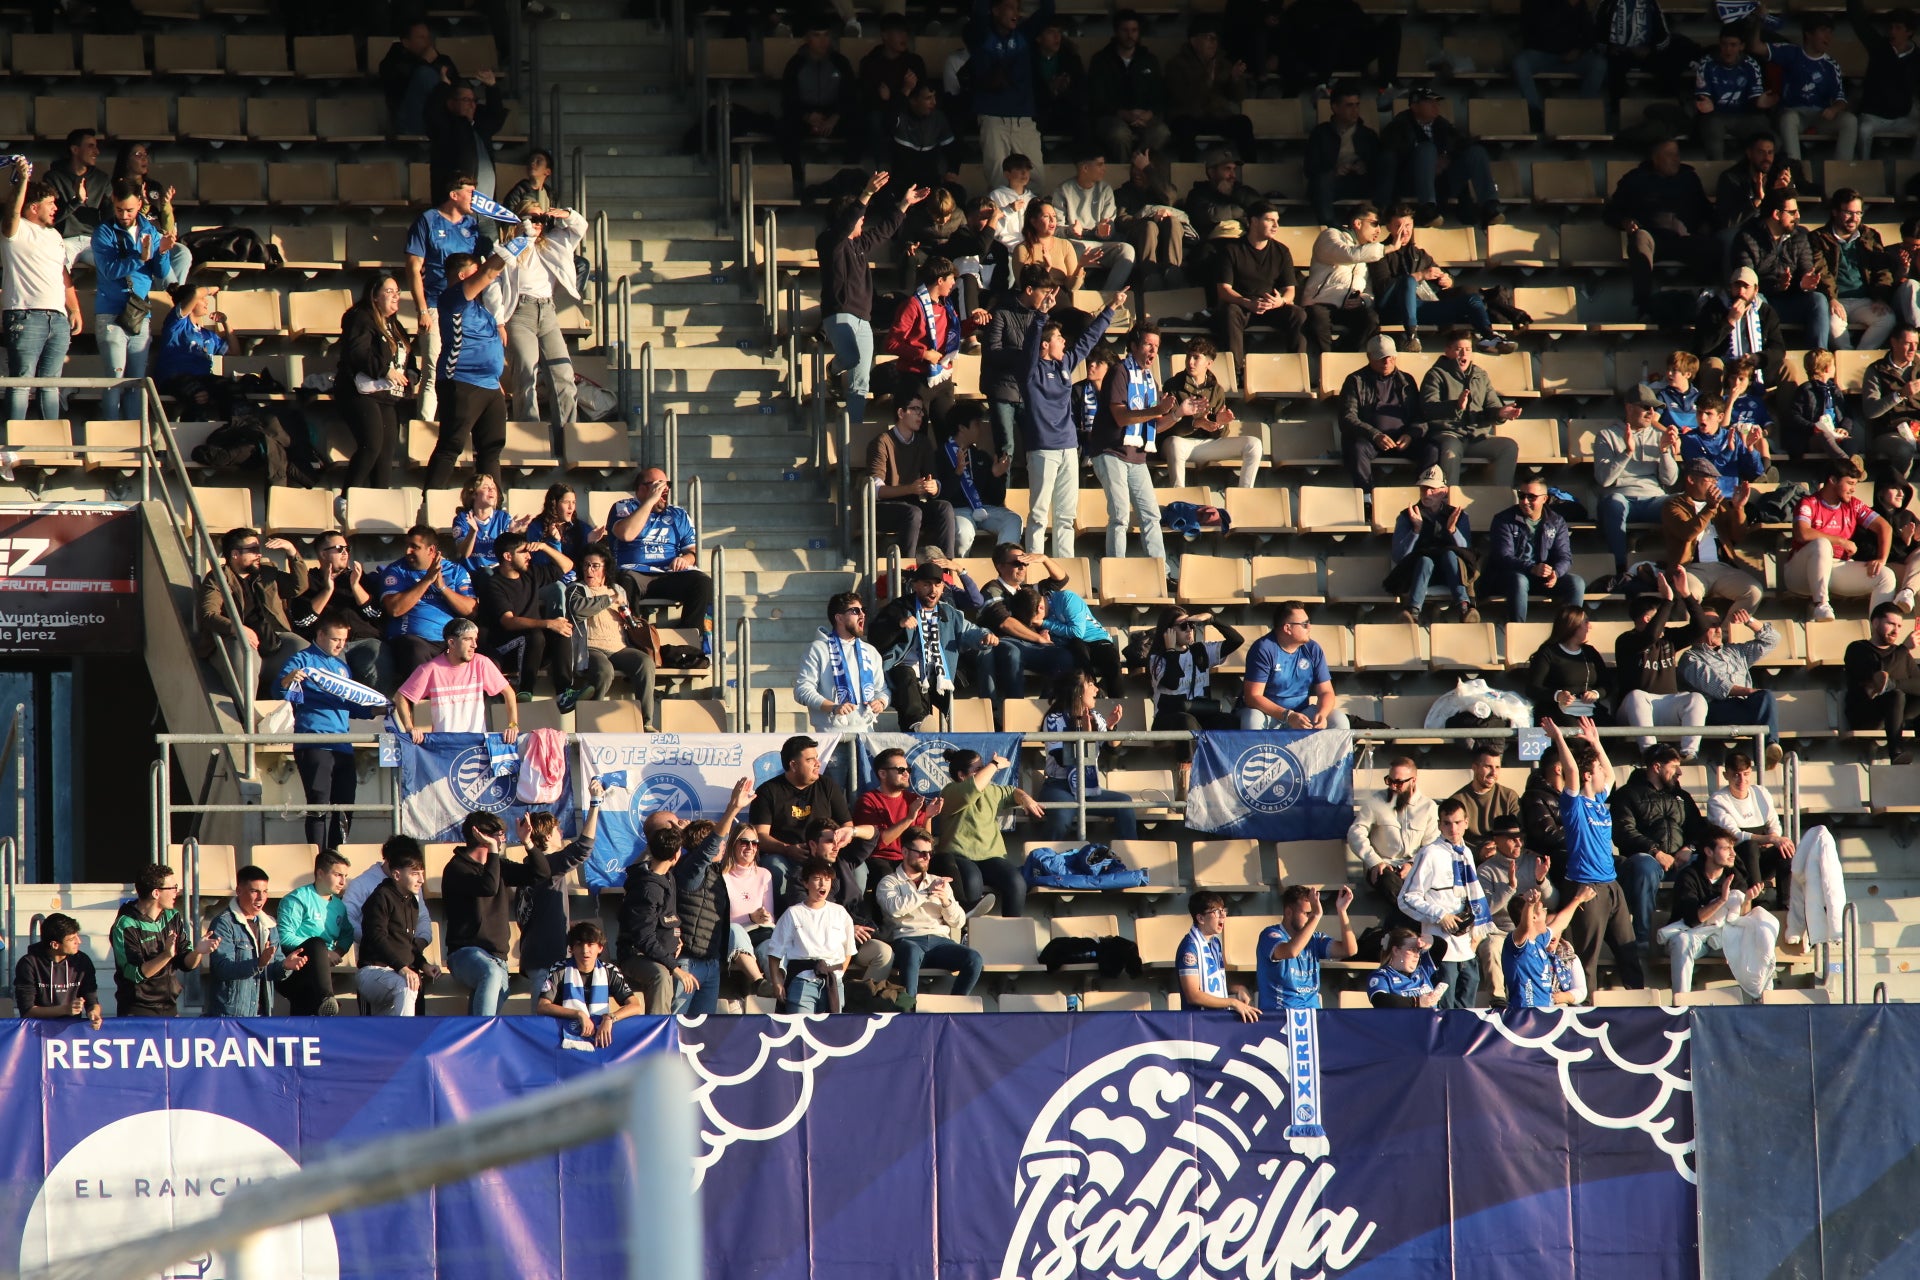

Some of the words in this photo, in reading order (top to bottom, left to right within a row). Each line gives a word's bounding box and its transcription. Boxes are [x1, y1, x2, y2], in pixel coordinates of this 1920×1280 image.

[715, 277, 724, 285] 12
[740, 341, 748, 349] 11
[815, 541, 820, 549] 8
[52, 581, 114, 592] COMPITE.
[0, 611, 105, 627] Ayuntamiento
[16, 628, 57, 643] Jerez
[319, 676, 349, 699] DONDE
[590, 746, 617, 765] YO
[621, 747, 647, 765] TE
[650, 743, 743, 767] SEGUIRÉ
[1258, 745, 1278, 754] 1911
[1252, 761, 1284, 797] XEREZ
[462, 795, 512, 813] DEPORTIVO
[1244, 793, 1295, 812] DEPORTIVO
[46, 1036, 322, 1070] RESTAURANTE
[75, 1178, 113, 1199] EL
[135, 1176, 280, 1198] RANC
[990, 1156, 1378, 1280] Isabella
